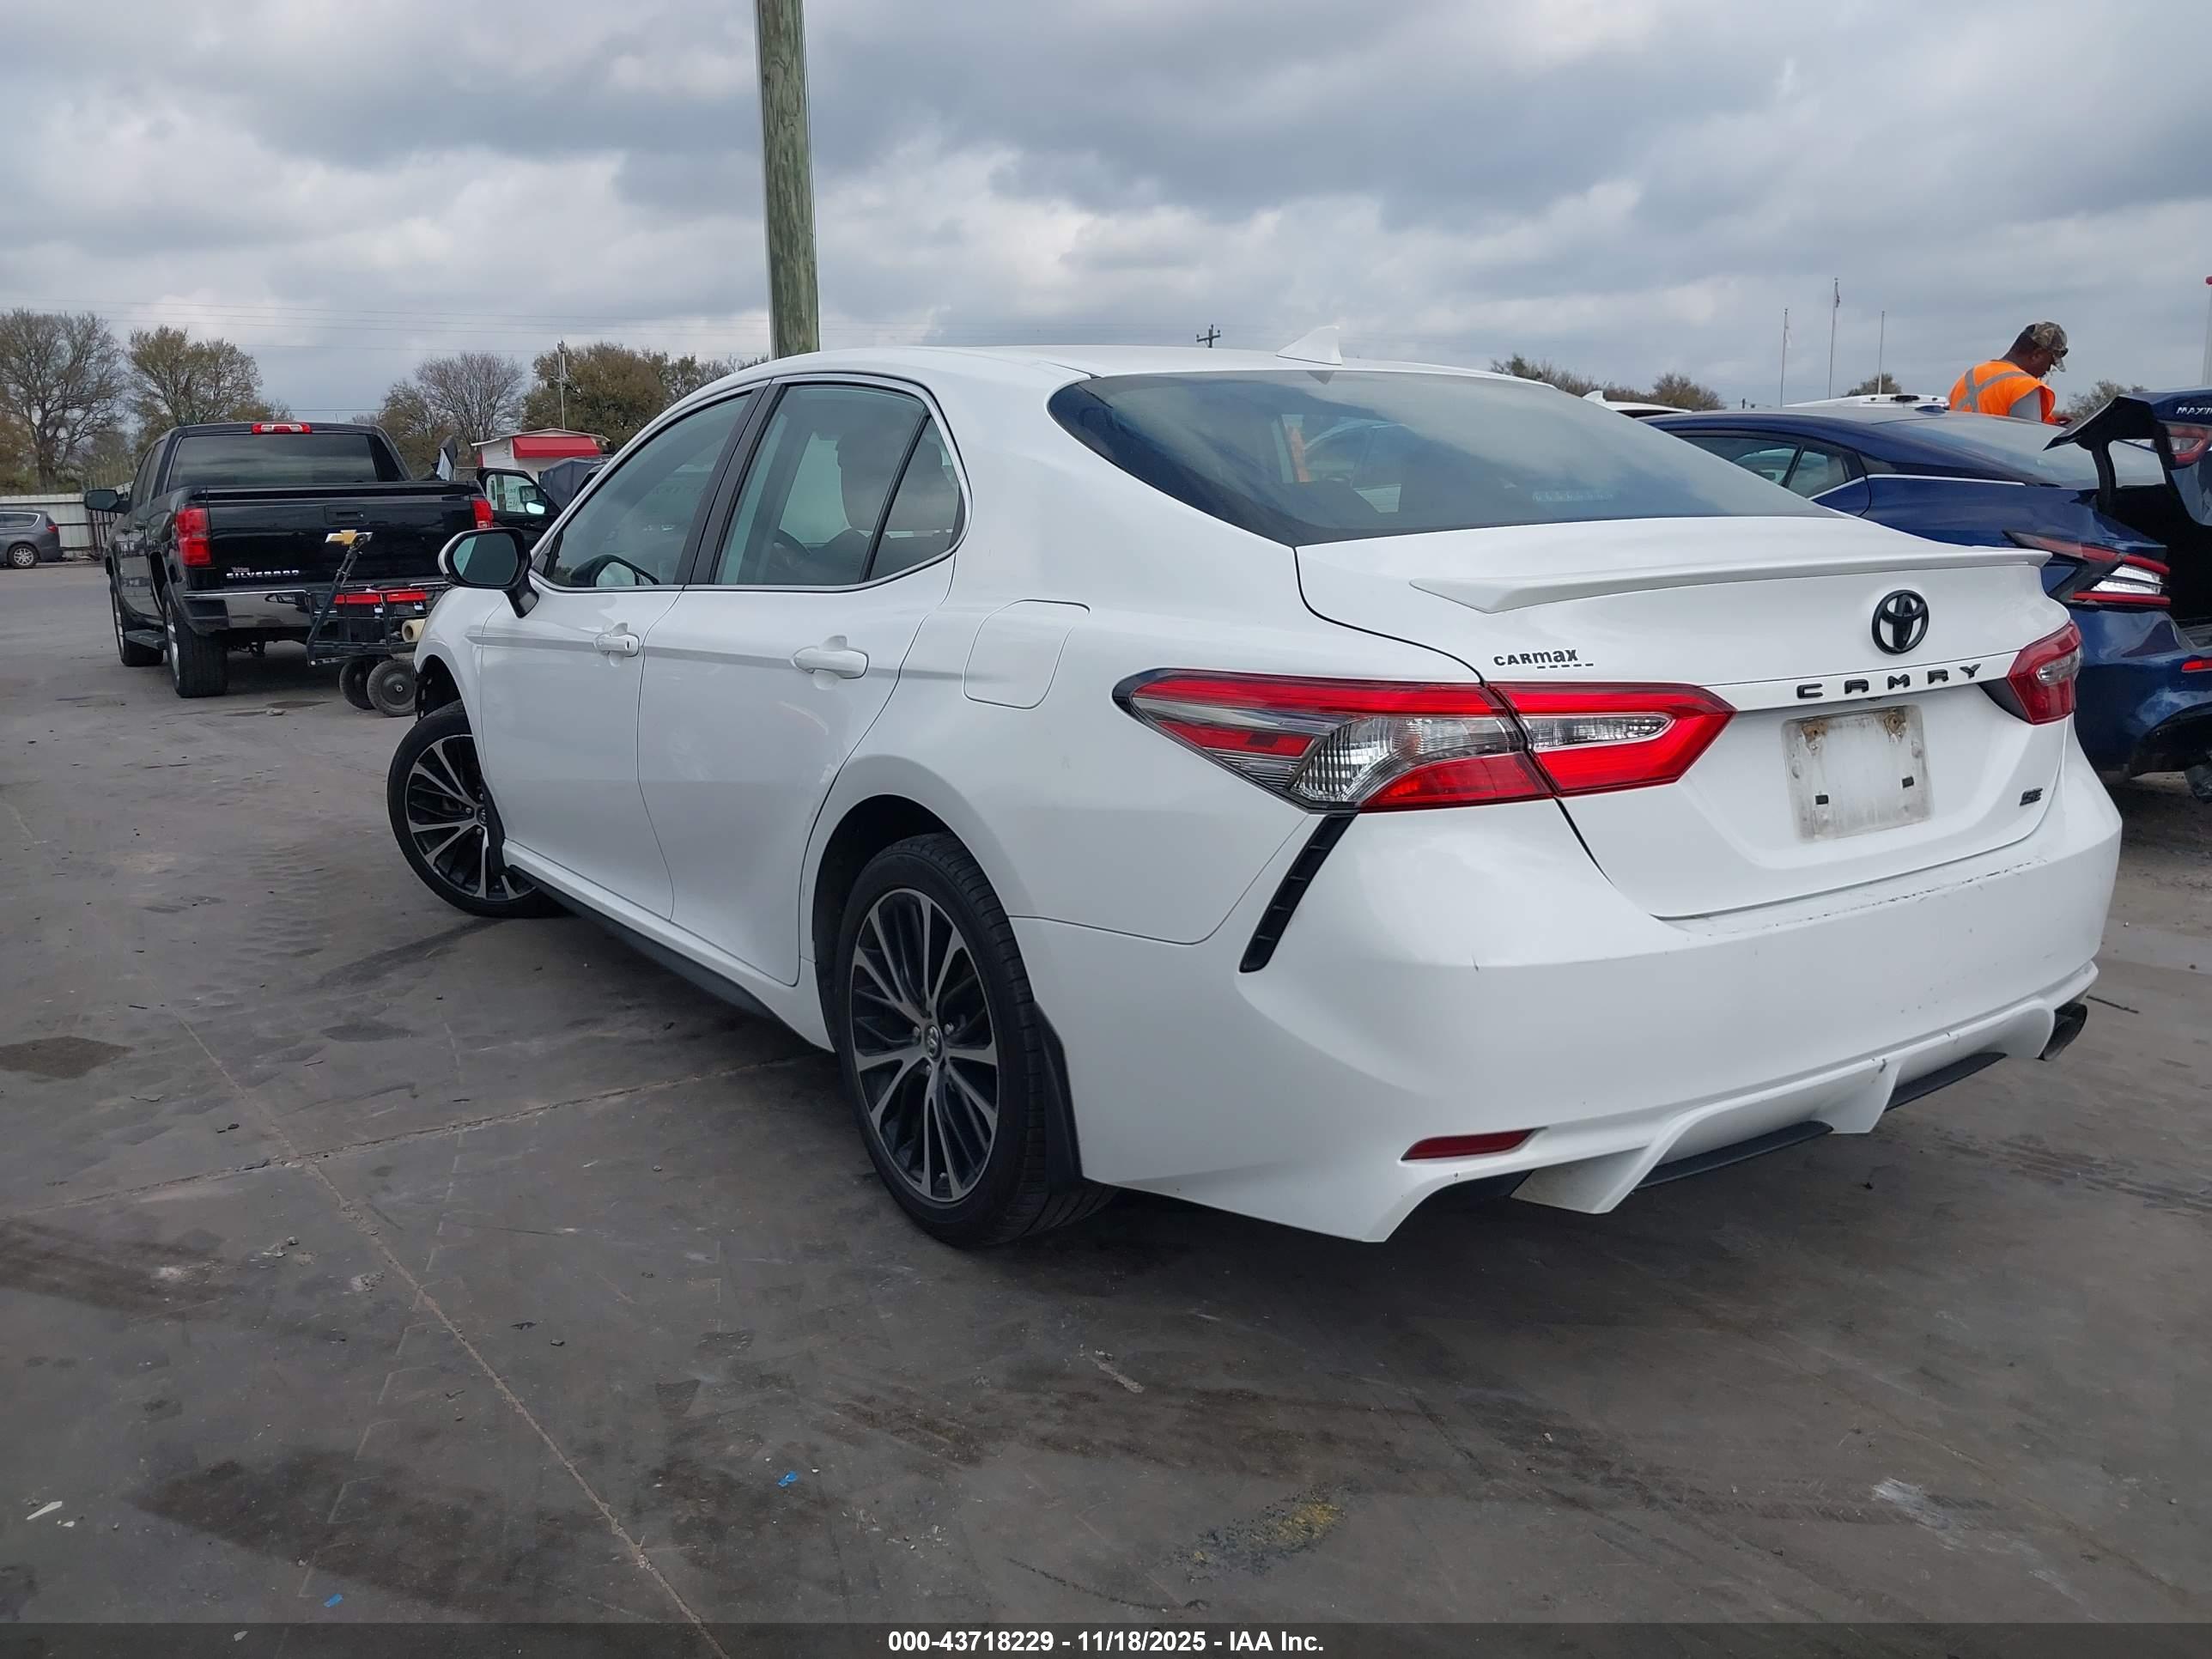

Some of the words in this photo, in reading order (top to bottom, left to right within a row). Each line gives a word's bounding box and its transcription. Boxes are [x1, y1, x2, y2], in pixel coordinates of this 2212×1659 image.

[2176, 406, 2212, 416] MAXI
[1796, 663, 1981, 699] CAMRY
[2020, 788, 2043, 806] SE
